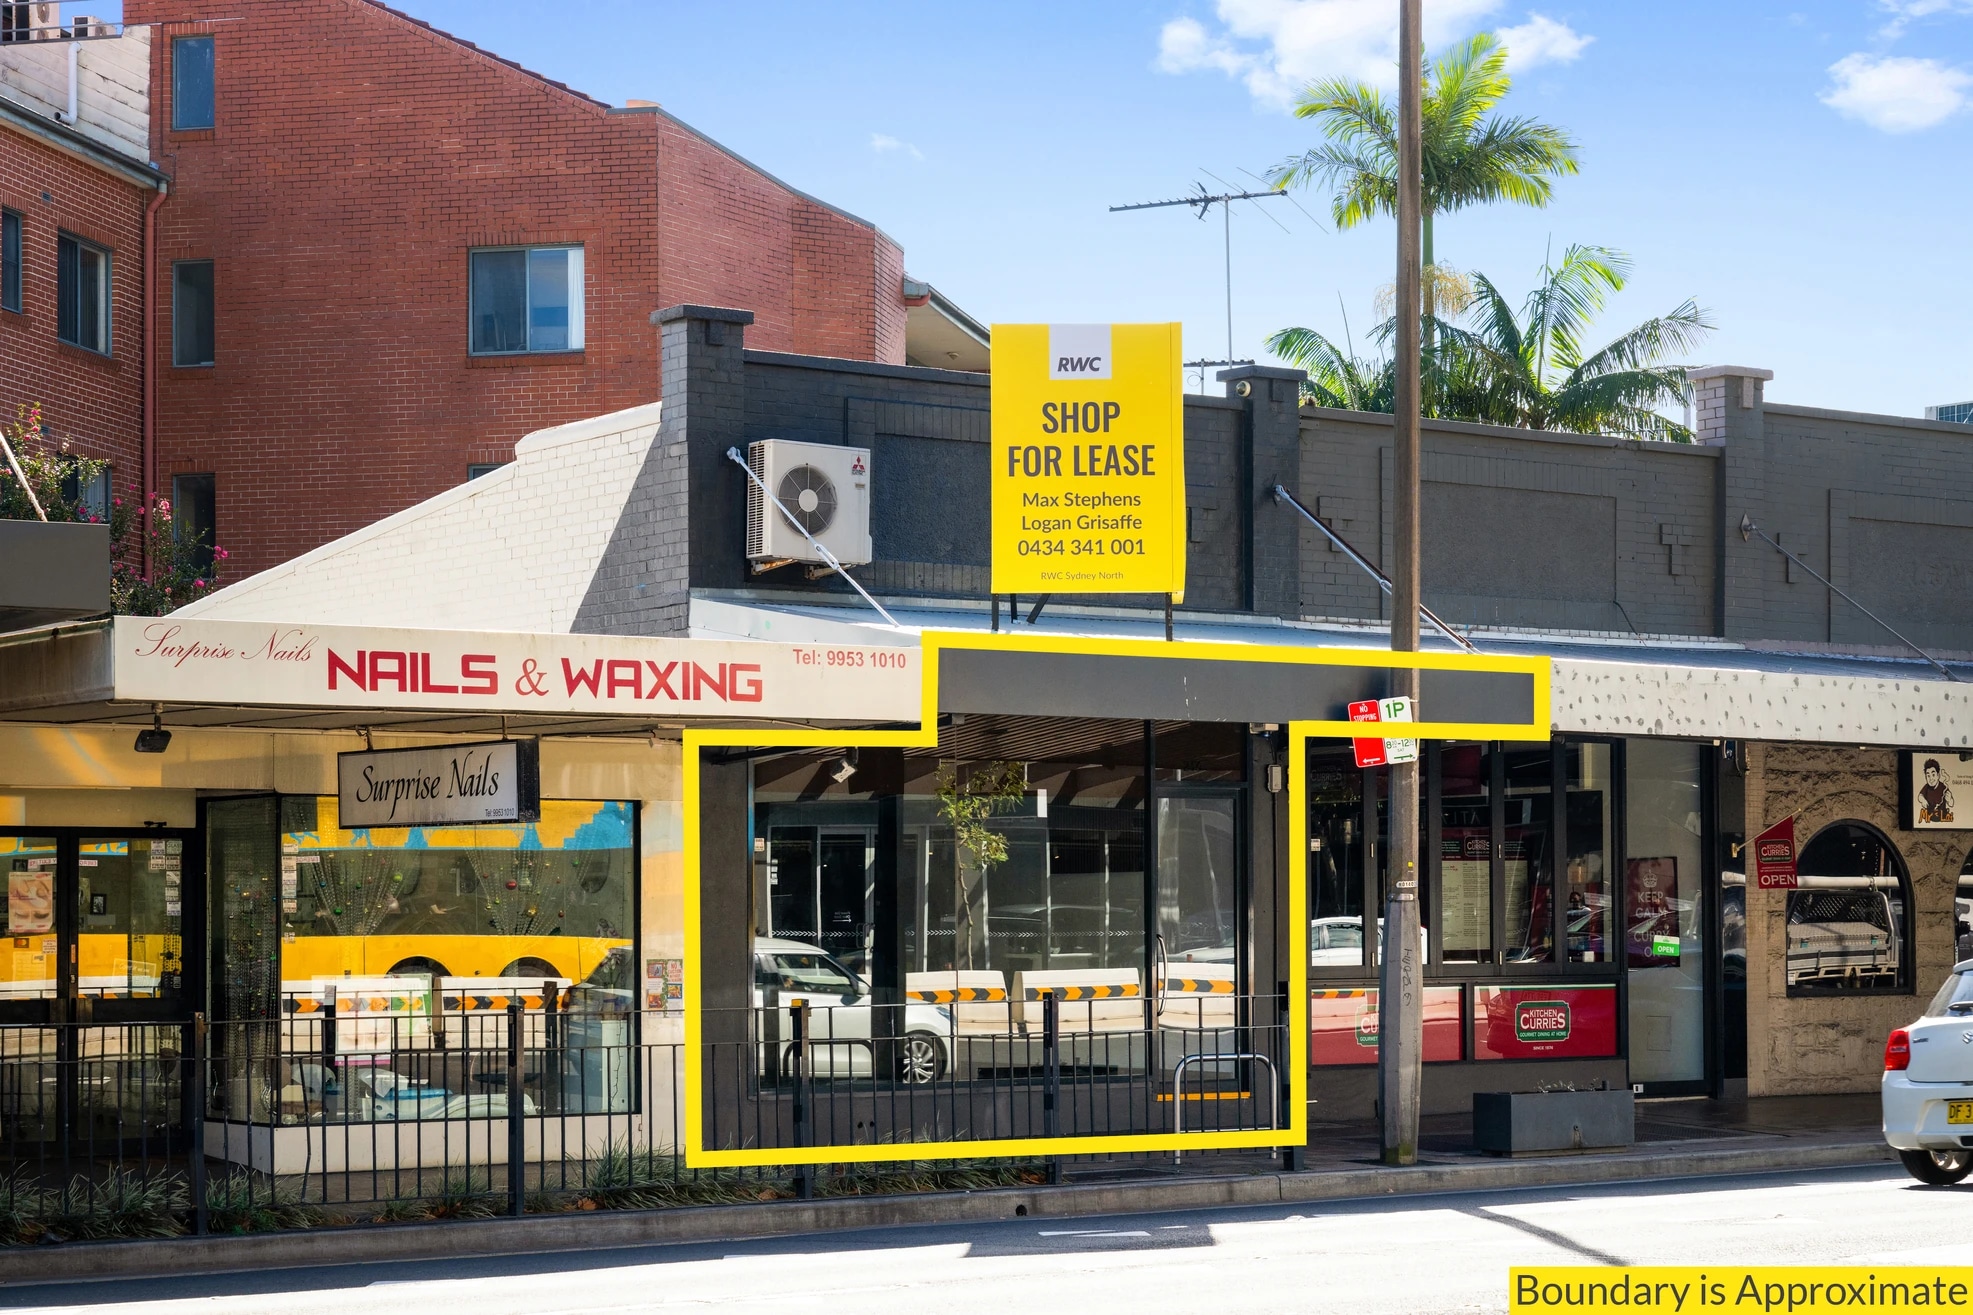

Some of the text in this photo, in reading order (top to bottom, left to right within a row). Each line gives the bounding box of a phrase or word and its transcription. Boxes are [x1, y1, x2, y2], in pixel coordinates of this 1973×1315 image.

[1057, 356, 1102, 372] RWC
[1042, 401, 1121, 434] SHOP
[1008, 444, 1156, 477] FOR LEASE
[1022, 491, 1141, 510] Max Stephens
[1022, 514, 1143, 533] Logan Grisaffe
[1017, 538, 1146, 556] 0434 341 001
[1041, 571, 1124, 581] RWC Sydney North
[135, 622, 320, 668] Surprise Nails
[792, 648, 907, 669] Tel: 9953 1010
[327, 647, 764, 703] NAILS & WAXING
[1353, 712, 1377, 722] STOPPING
[1359, 705, 1369, 713] NO
[1385, 701, 1405, 719] 1P
[356, 750, 499, 822] Surprise Nails
[1761, 846, 1790, 857] CURRIES
[1760, 874, 1796, 886] OPEN
[1637, 891, 1664, 903] KEEP
[1635, 907, 1667, 919] CALM
[1657, 945, 1675, 954] OPEN
[1520, 1012, 1566, 1030] CURRIES
[1529, 1009, 1558, 1018] KITCHEN
[1949, 1104, 1962, 1119] DF
